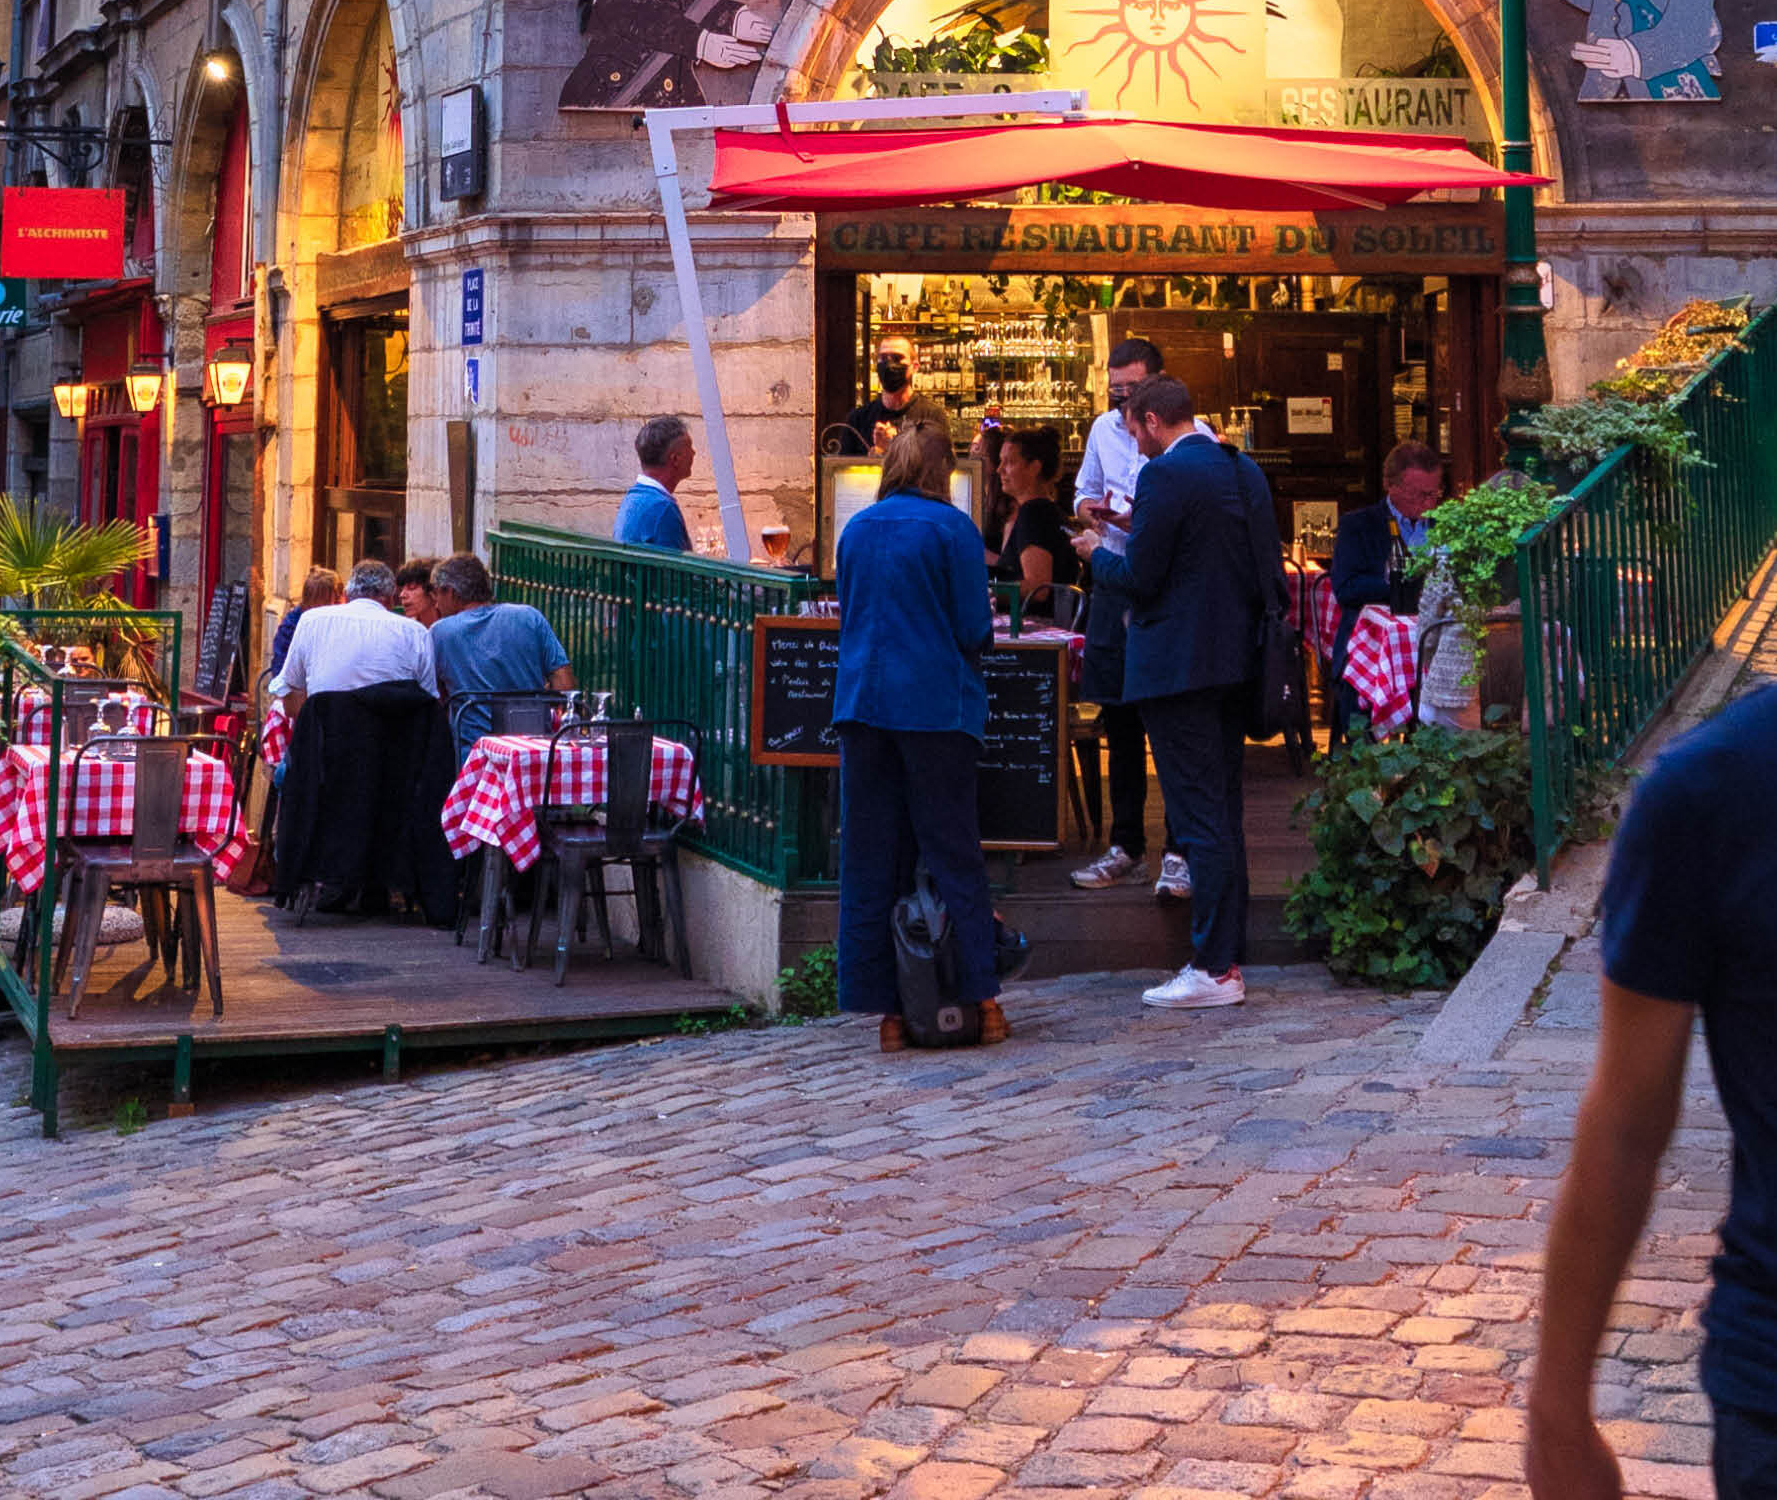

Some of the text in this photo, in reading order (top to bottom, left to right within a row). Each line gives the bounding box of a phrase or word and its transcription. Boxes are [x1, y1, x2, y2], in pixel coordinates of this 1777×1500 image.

[1280, 86, 1471, 127] RESTAURANT
[17, 227, 109, 240] L'ALCHIMISTE
[959, 222, 1256, 255] RESTAURANT
[1272, 223, 1335, 255] DU
[1352, 224, 1497, 256] SOLEIL
